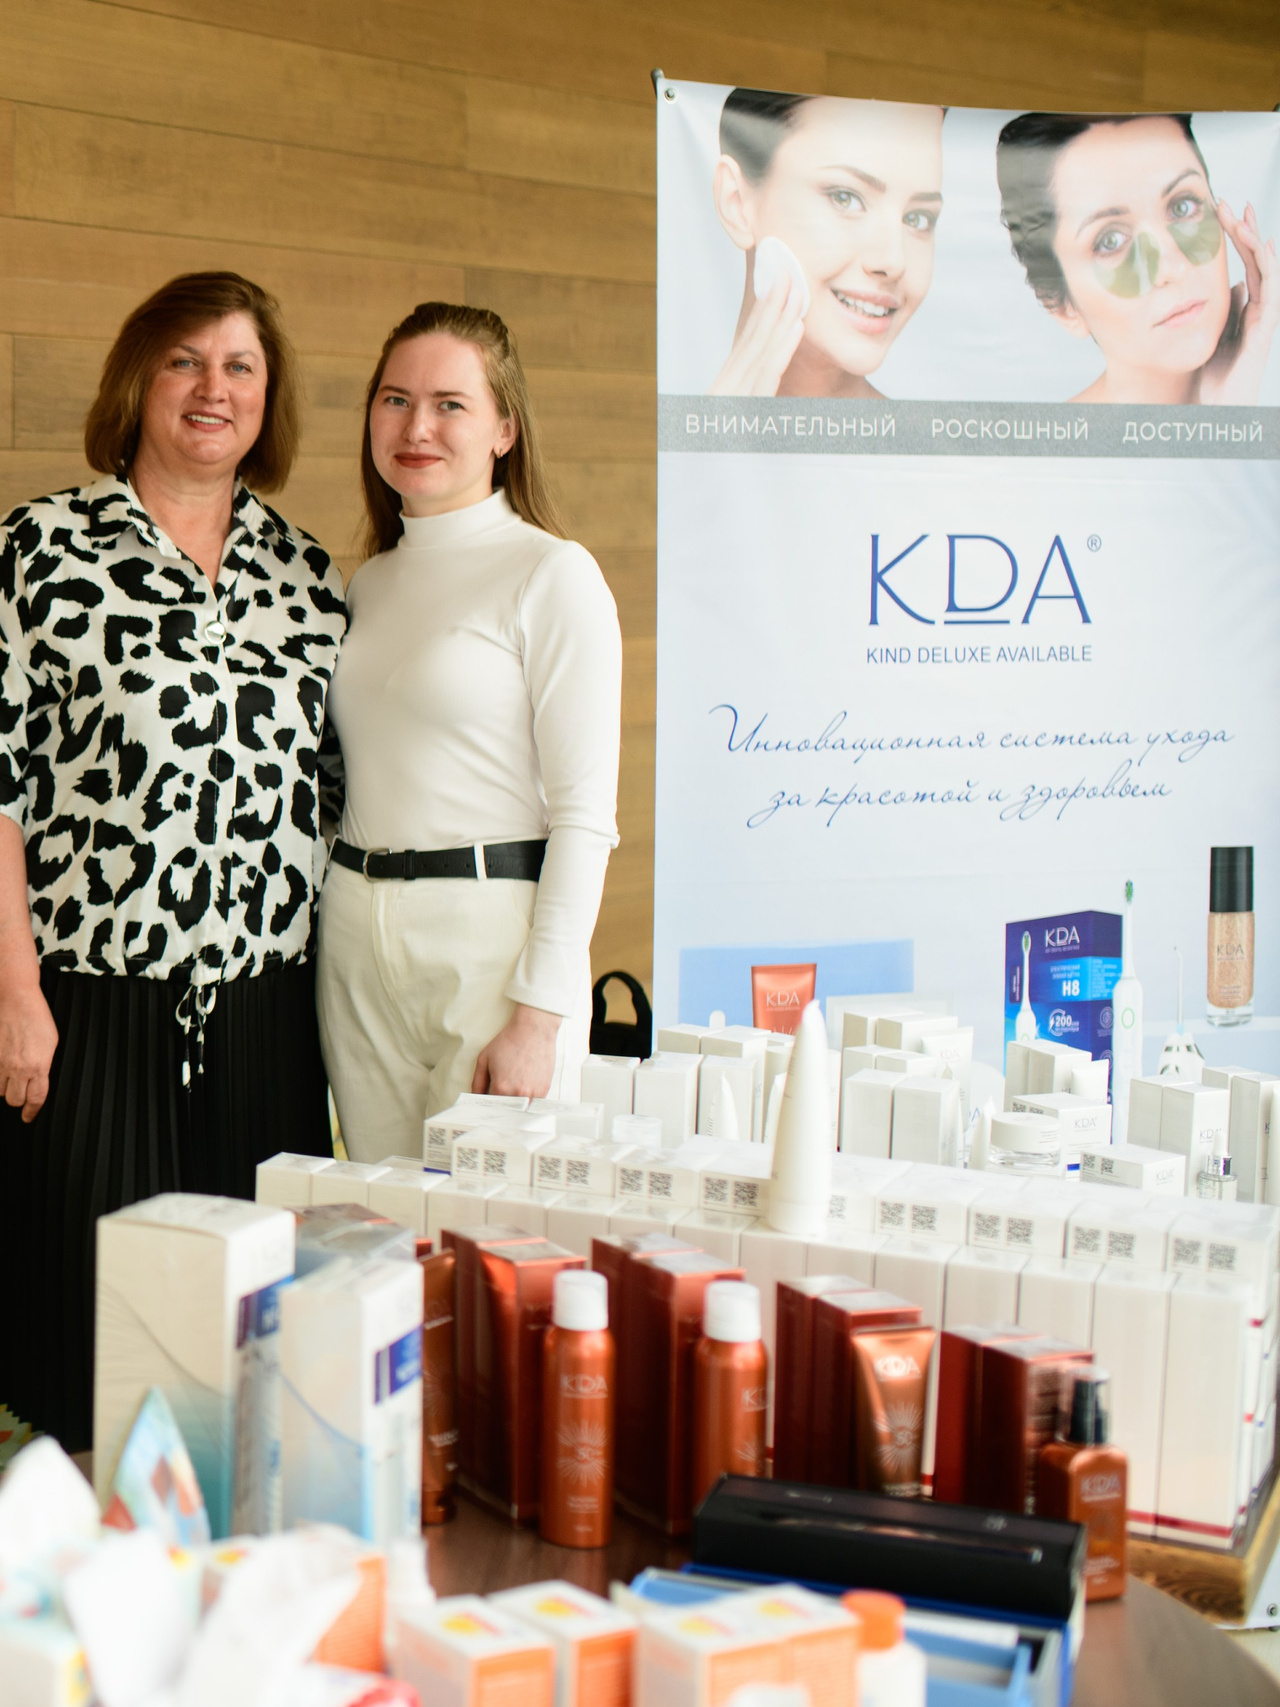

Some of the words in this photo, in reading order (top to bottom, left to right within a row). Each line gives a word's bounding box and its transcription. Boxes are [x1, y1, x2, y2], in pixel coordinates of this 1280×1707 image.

[685, 413, 897, 438] ВНИМАТЕЛЬНЫЙ
[931, 416, 1089, 441] РОСКОШНЫЙ
[1122, 420, 1264, 444] ДОСТУПНЫЙ
[866, 646, 912, 664] KIND
[917, 645, 991, 664] DELUXE
[996, 644, 1092, 662] AVAILABLE
[708, 703, 991, 764] Инновационная
[999, 731, 1139, 749] система
[1137, 729, 1235, 767] ухода
[746, 790, 809, 828] за
[815, 779, 980, 828] красотой
[988, 788, 1010, 802] и
[999, 758, 1173, 822] здоровьем
[1044, 925, 1080, 948] KDA
[765, 989, 801, 1007] KDA
[1062, 979, 1081, 998] H8
